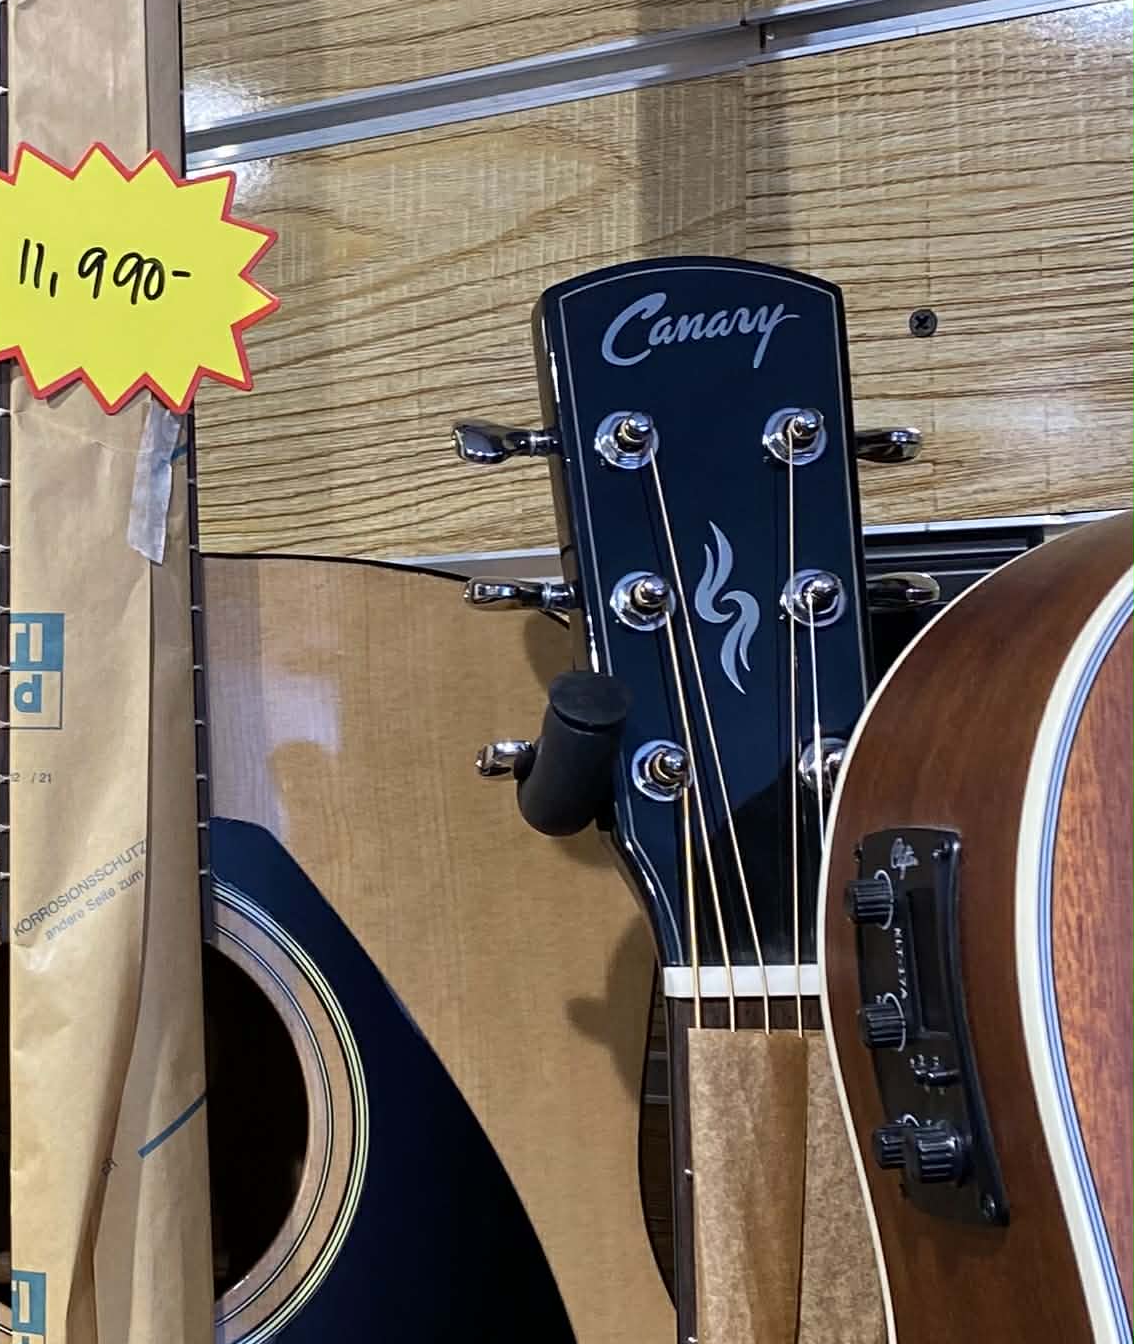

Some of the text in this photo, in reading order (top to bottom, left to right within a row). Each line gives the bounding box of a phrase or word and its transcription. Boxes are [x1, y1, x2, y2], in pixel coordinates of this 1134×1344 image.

[601, 292, 801, 369] Canary
[86, 886, 116, 913] Seite
[119, 870, 145, 891] zum
